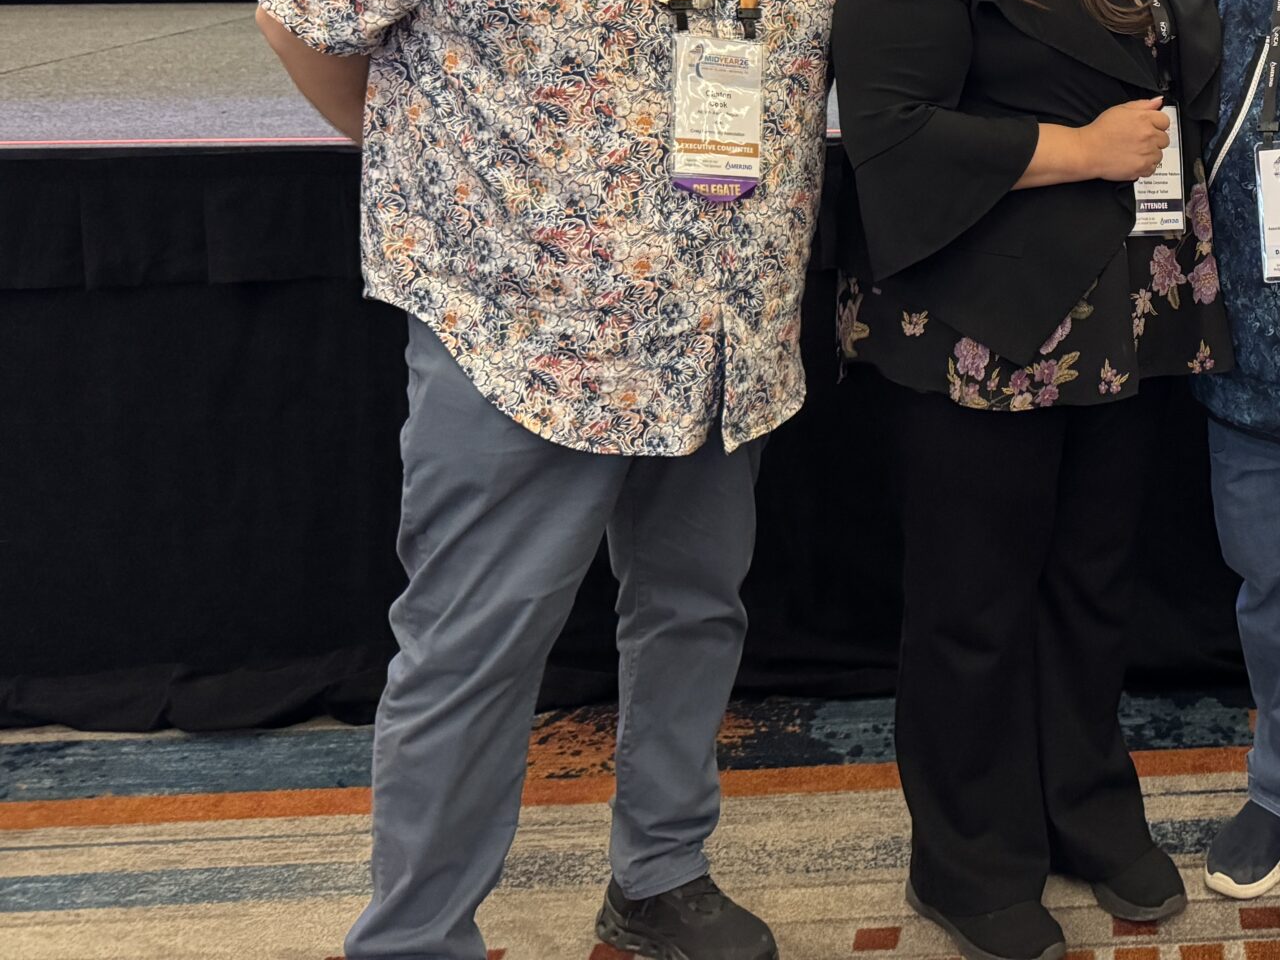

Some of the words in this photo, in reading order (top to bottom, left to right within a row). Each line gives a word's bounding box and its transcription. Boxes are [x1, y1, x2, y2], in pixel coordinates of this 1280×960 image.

[1268, 61, 1277, 88] AMERIND
[705, 89, 732, 99] Cinton
[680, 142, 716, 152] EXECUTIVE
[725, 161, 753, 170] AMERIND
[693, 183, 741, 196] DELEGATE
[1140, 202, 1169, 210] ATTENDEE
